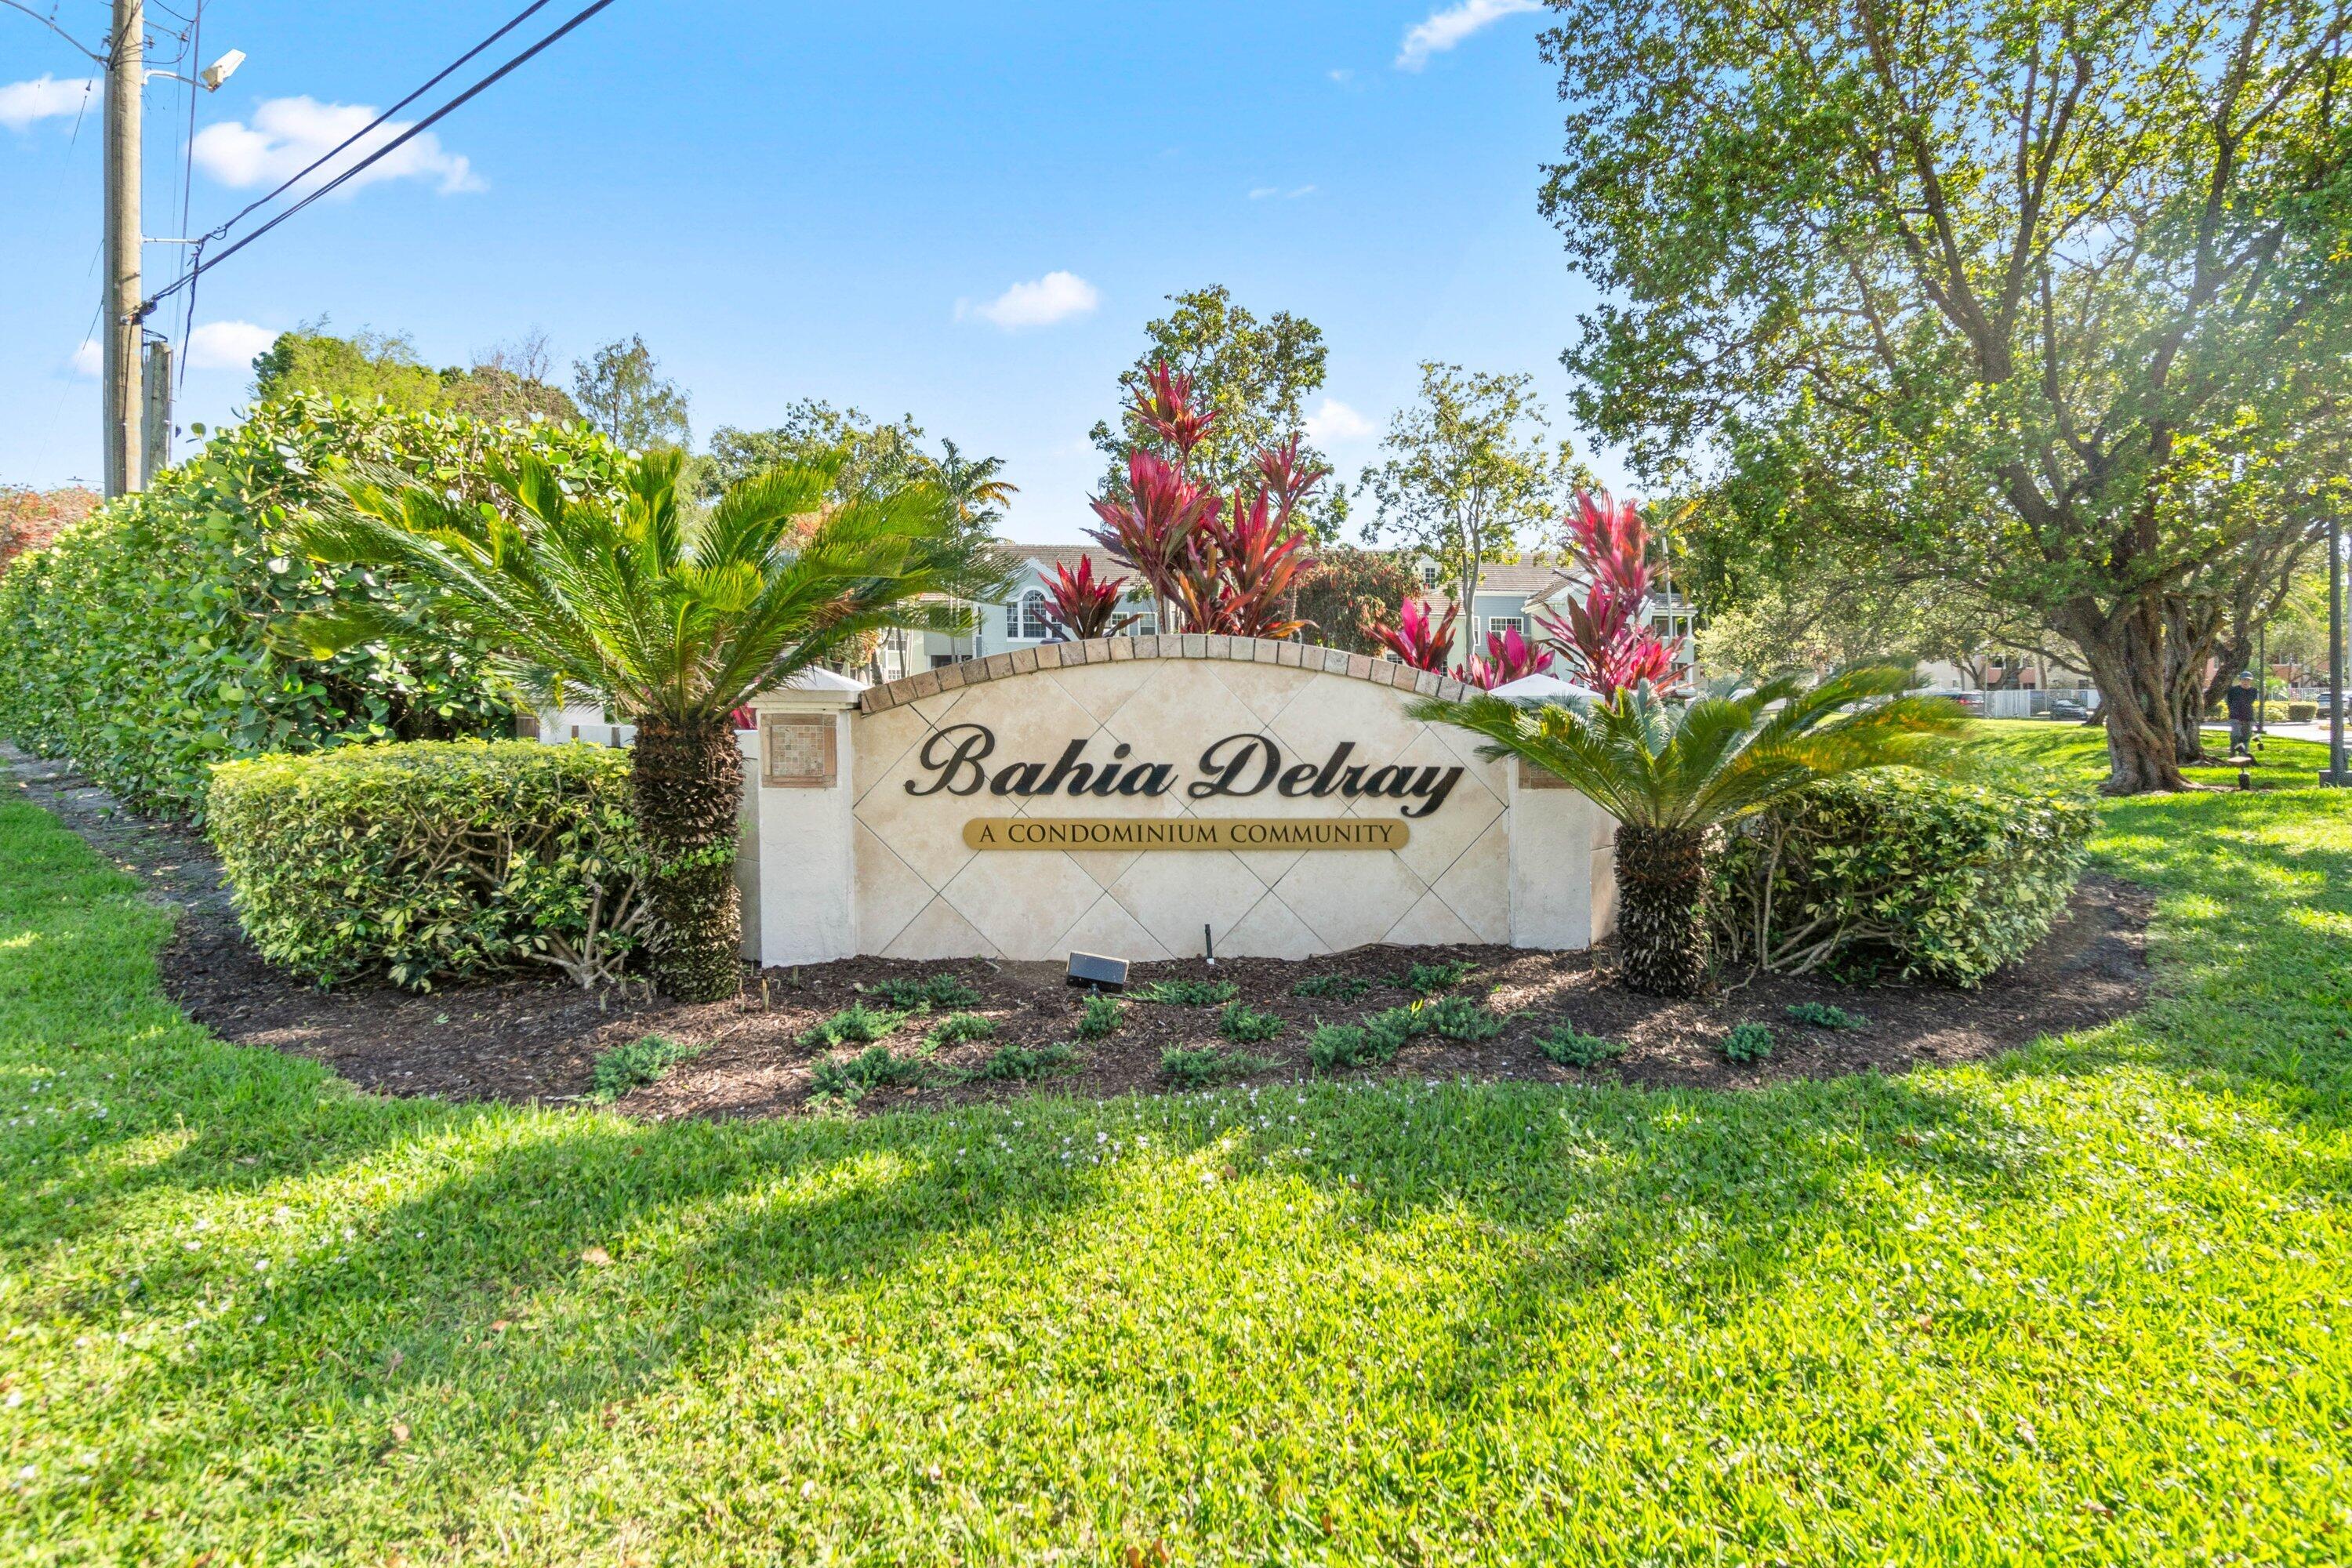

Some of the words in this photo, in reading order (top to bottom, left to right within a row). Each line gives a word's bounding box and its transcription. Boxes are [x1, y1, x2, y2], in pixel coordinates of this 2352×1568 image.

[904, 724, 1178, 797] Bahia
[1187, 734, 1465, 818] Delray
[979, 824, 996, 843] A
[1007, 824, 1218, 844] CONDOMINIUM
[1229, 824, 1394, 844] COMMUNITY
